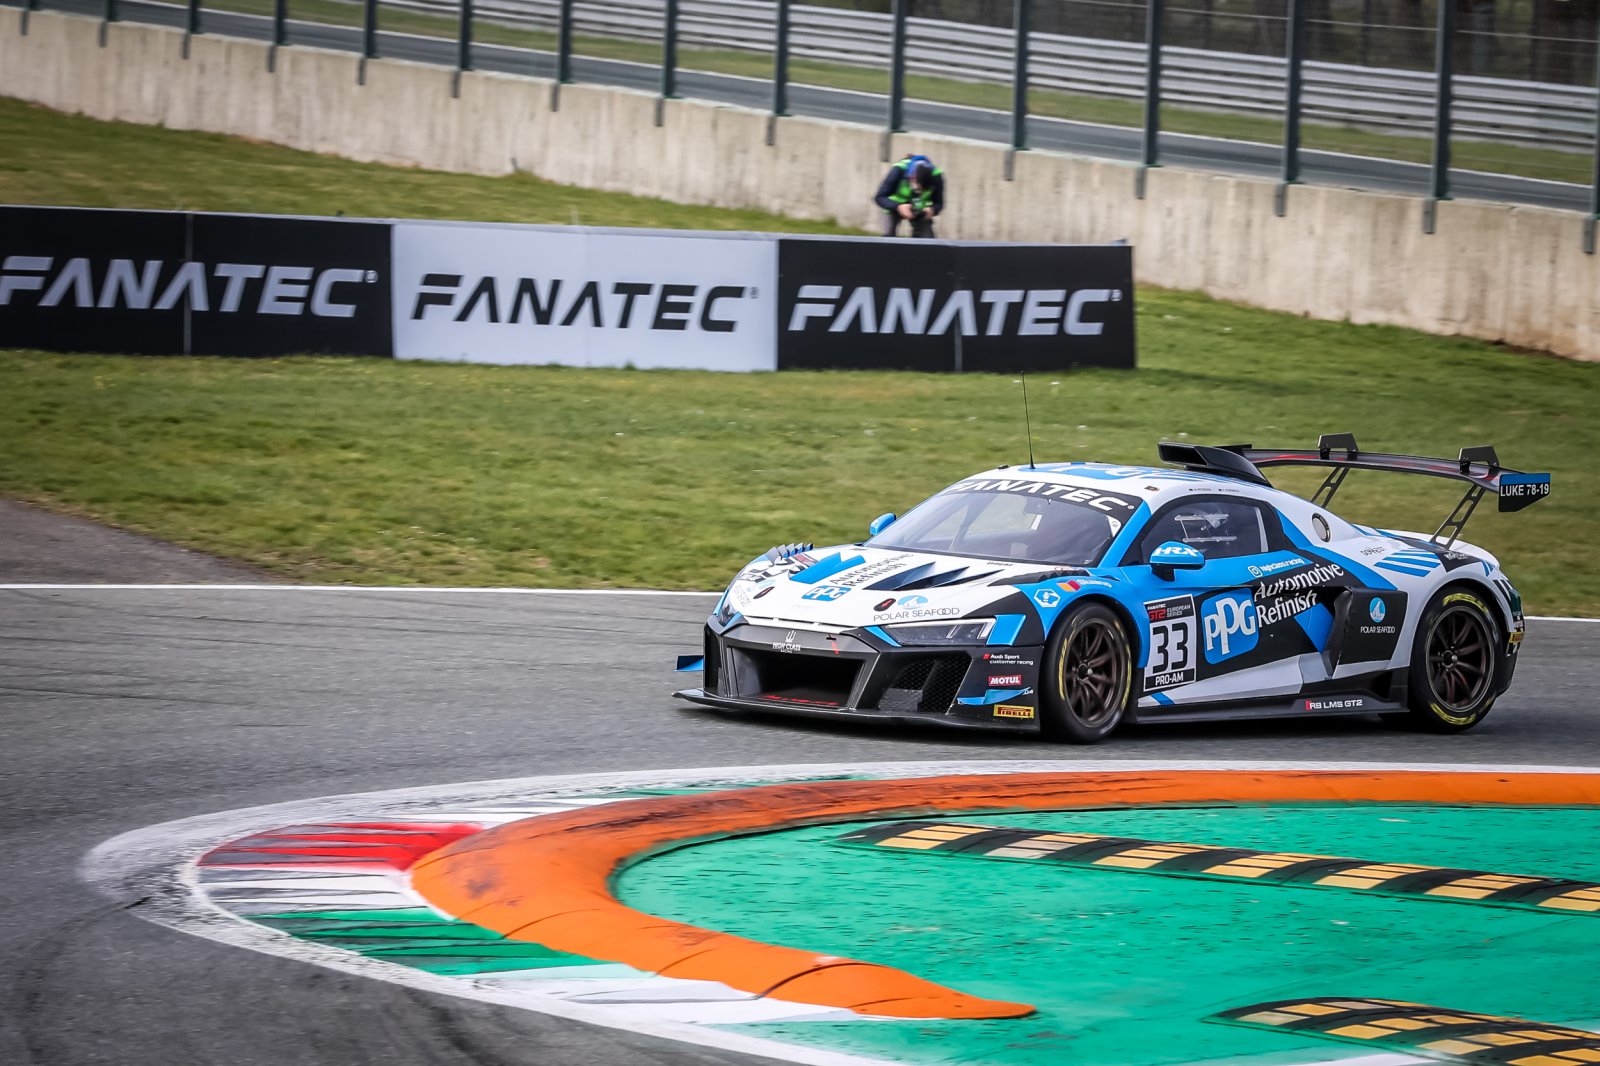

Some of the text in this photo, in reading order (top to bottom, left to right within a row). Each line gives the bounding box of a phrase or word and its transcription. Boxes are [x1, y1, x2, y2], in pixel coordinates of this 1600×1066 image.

[0, 255, 364, 317] FANATEC
[410, 273, 746, 334] FANATEC
[788, 284, 1111, 336] FANATEC
[1500, 483, 1549, 497] LUKE 78-19
[1152, 546, 1198, 557] HRX
[1254, 563, 1344, 602] Automotive
[804, 585, 848, 600] PPG
[873, 608, 960, 621] POLAR SEAFOOD
[1166, 604, 1191, 612] EUROPEAN
[1256, 589, 1317, 628] Refinish
[1360, 626, 1395, 634] POLAR SEAFOOD
[1152, 622, 1188, 674] 33
[990, 676, 1020, 685] MOTUL
[1155, 672, 1184, 686] PRO-AM
[1344, 699, 1363, 707] GT2
[997, 706, 1032, 716] PIRELLI
